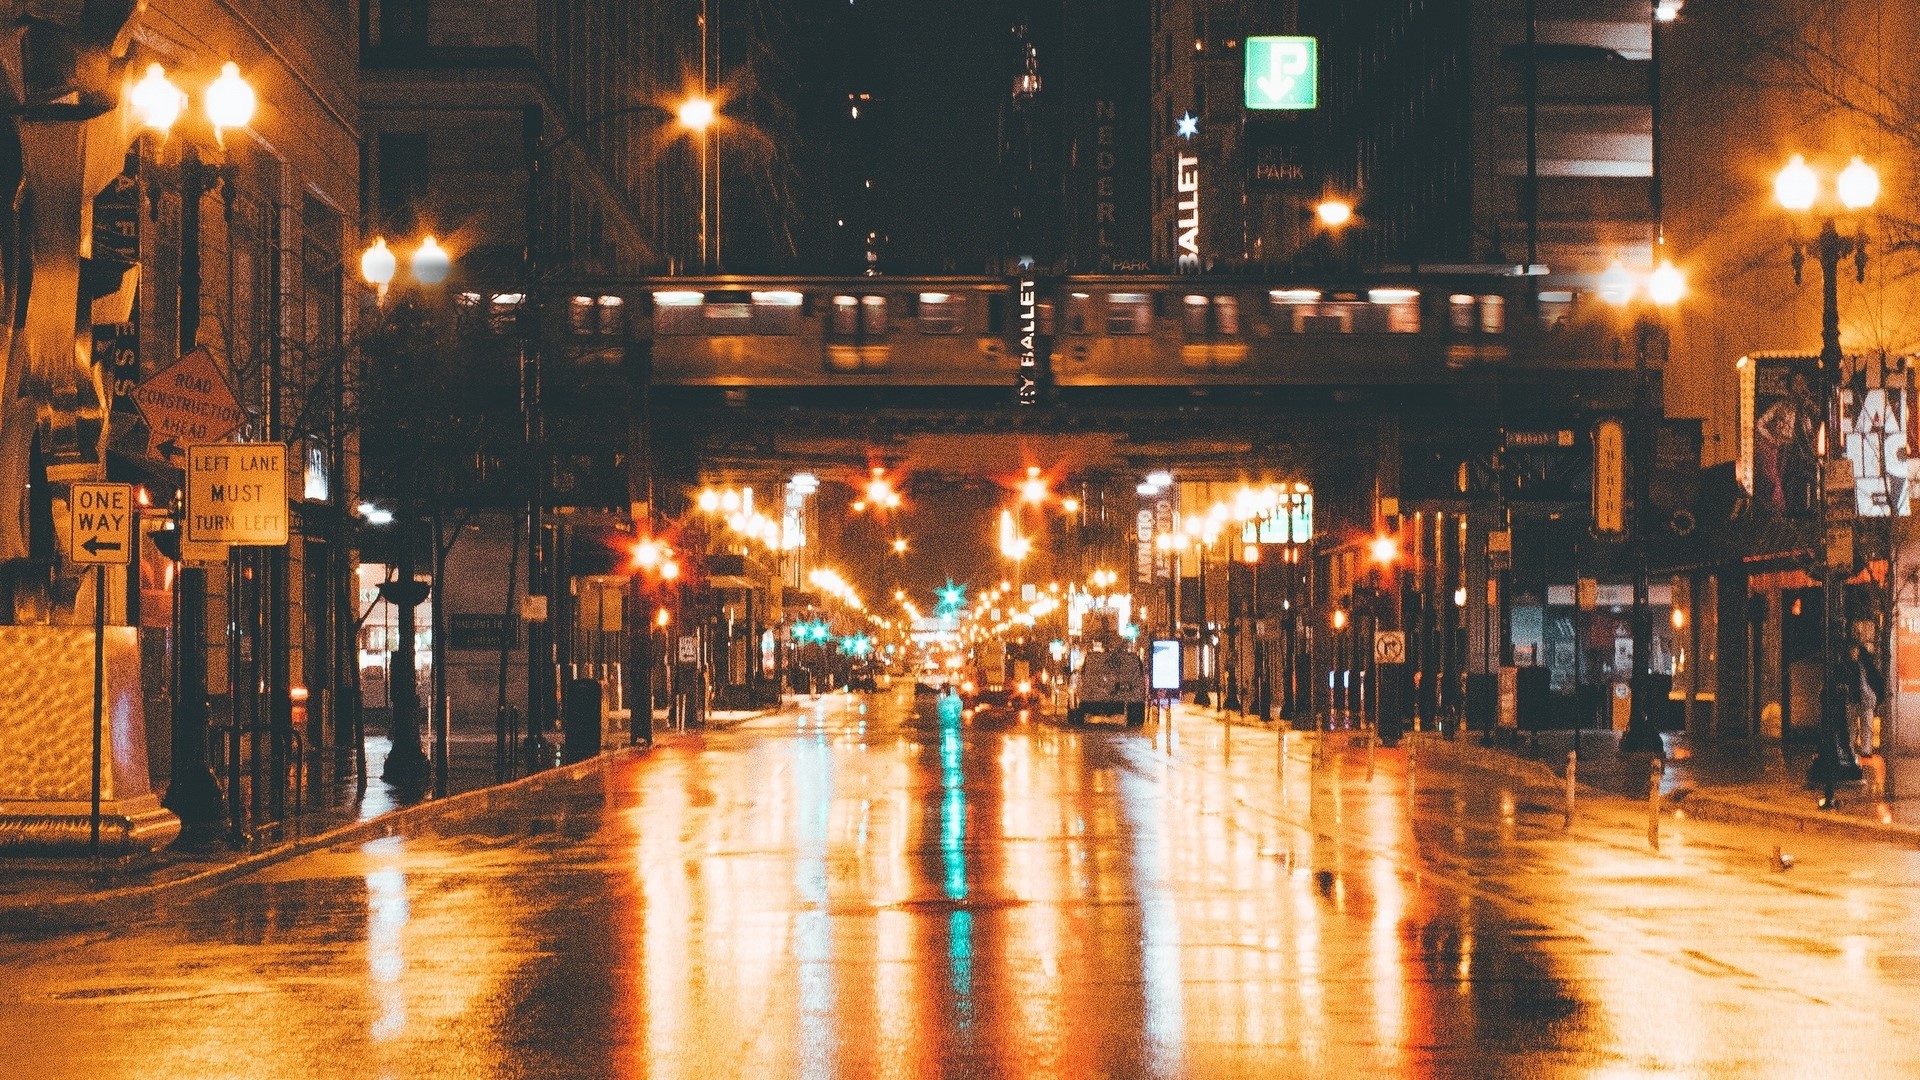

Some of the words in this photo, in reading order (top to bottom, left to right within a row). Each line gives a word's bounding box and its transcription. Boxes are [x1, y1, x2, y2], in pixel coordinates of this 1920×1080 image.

[1255, 164, 1305, 181] PARK
[1177, 152, 1199, 272] BALLET
[1019, 278, 1036, 368] BALLET
[176, 373, 211, 394] ROAD
[137, 388, 241, 424] CONSTRUCTION
[161, 417, 207, 439] AHEAD
[194, 456, 229, 472] LEFT
[241, 456, 279, 472] LANE
[79, 491, 124, 509] ONE
[211, 484, 263, 503] MUST
[79, 513, 125, 531] WAY
[194, 515, 235, 531] TURN
[244, 515, 280, 531] LEFT
